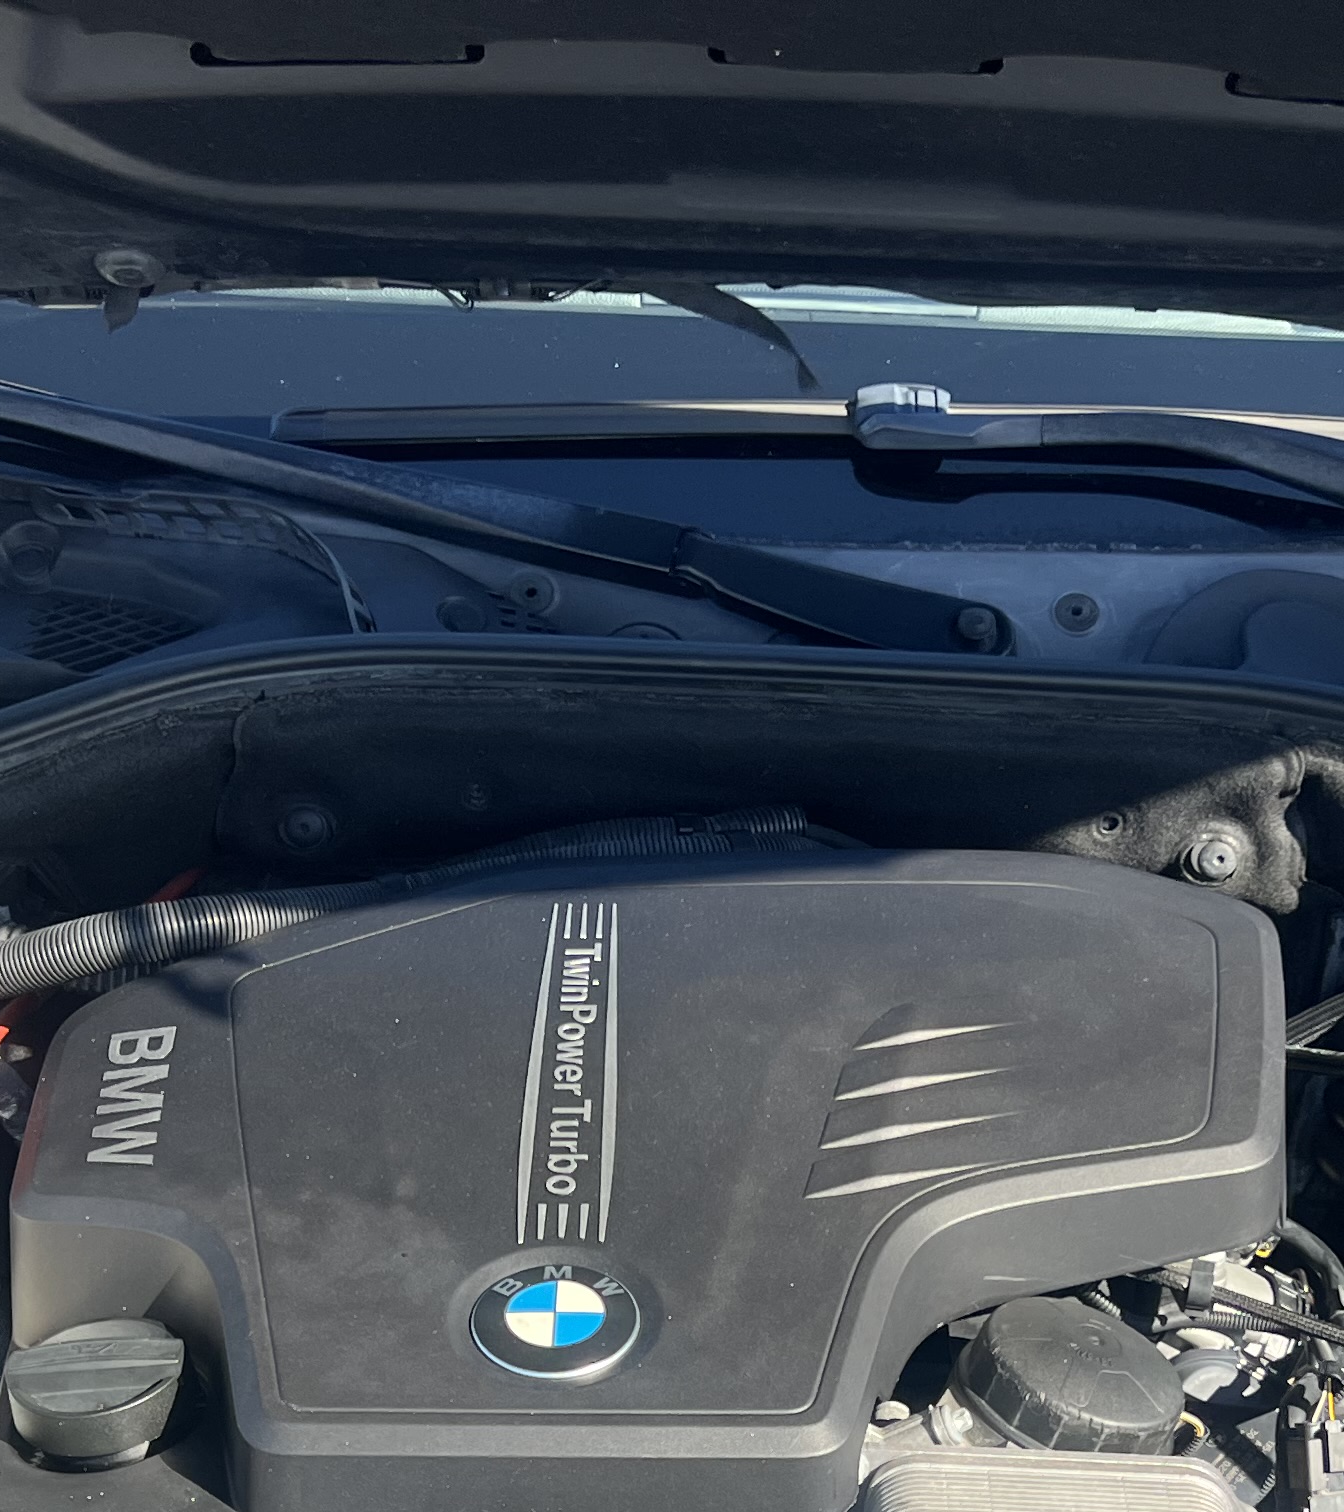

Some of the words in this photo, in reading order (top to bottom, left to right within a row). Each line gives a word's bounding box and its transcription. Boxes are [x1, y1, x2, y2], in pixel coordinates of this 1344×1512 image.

[553, 942, 602, 1096] TwinPower
[87, 1026, 177, 1165] BMW
[545, 1099, 592, 1196] Turbo
[492, 1265, 624, 1297] BMW
